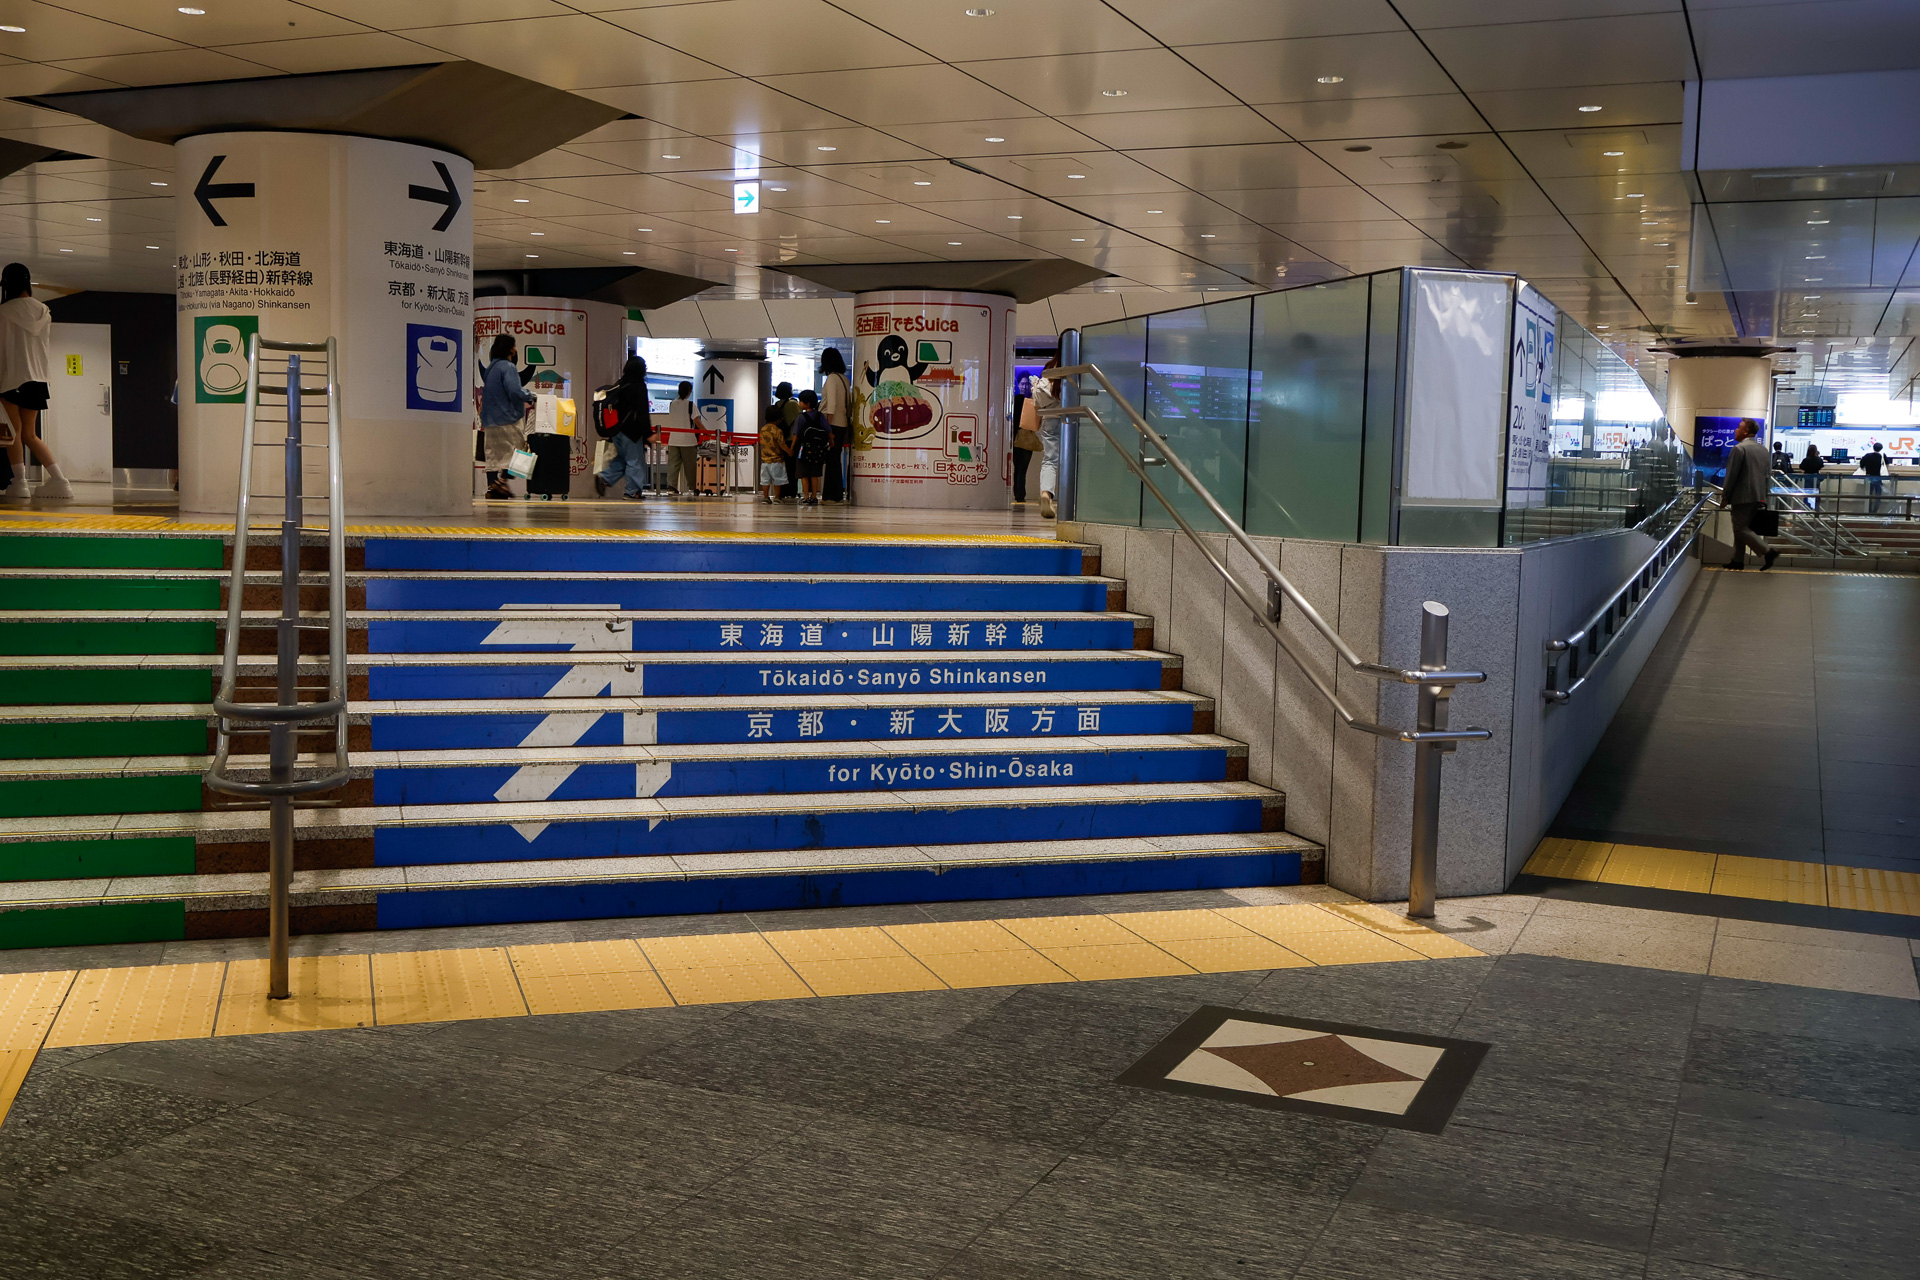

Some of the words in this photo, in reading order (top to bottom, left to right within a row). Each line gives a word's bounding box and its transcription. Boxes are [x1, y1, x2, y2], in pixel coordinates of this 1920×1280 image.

[222, 300, 255, 311] Nagano)
[257, 300, 311, 310] Shinkansen
[401, 300, 413, 309] for
[502, 319, 566, 335] でもSuica
[892, 315, 959, 333] でもSuica
[1889, 437, 1915, 451] JR
[949, 473, 977, 484] Suica
[719, 622, 1044, 647] 東海道・山陽新幹線
[929, 667, 1048, 685] Shinkansen
[828, 764, 860, 783] for
